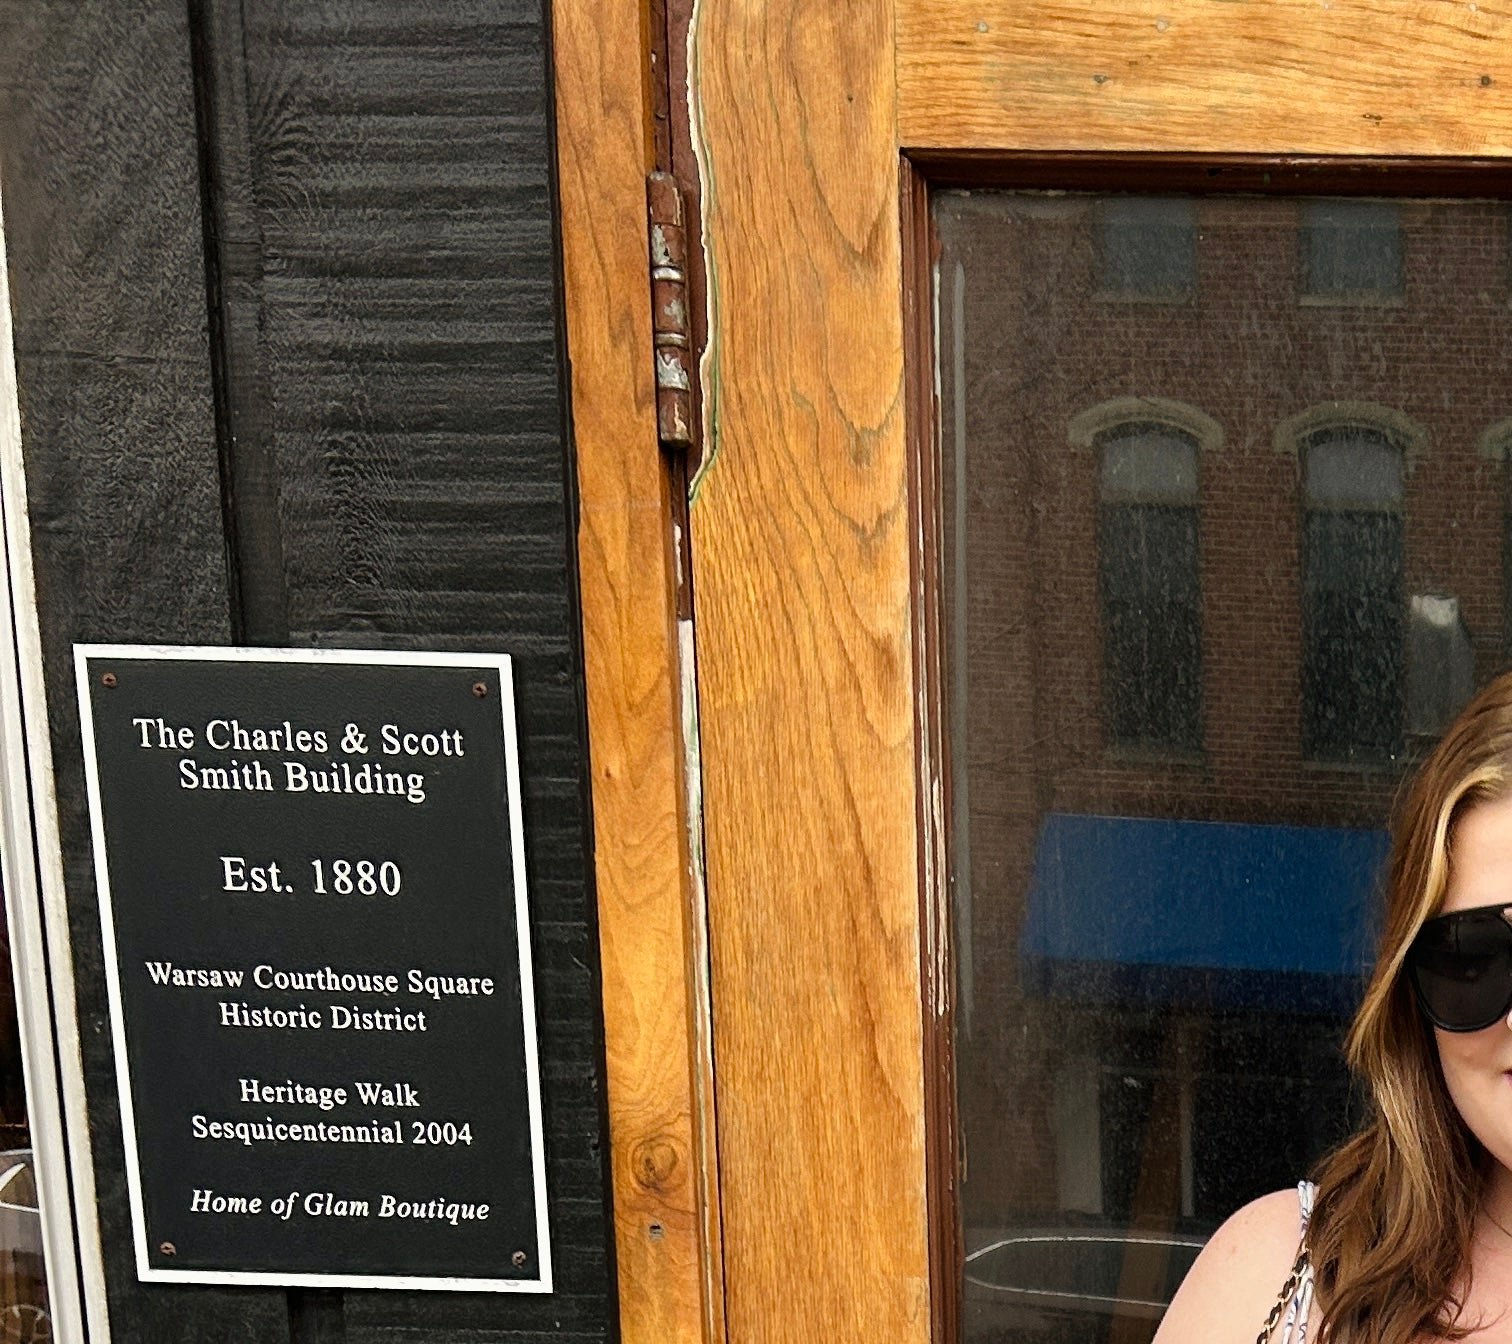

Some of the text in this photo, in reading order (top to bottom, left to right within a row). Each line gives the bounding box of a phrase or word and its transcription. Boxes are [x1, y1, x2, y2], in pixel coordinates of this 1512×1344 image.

[132, 717, 465, 757] The Charles & Scott
[179, 759, 426, 804] Smith Building
[219, 856, 401, 897] Est. 1880
[144, 961, 494, 999] Warsaw Courthouse Square
[218, 1002, 427, 1031] Historic District
[238, 1078, 420, 1110] Heritage Walk
[192, 1114, 473, 1146] Sesquicentennial 2004
[190, 1189, 490, 1223] Home of Glam Boutique
